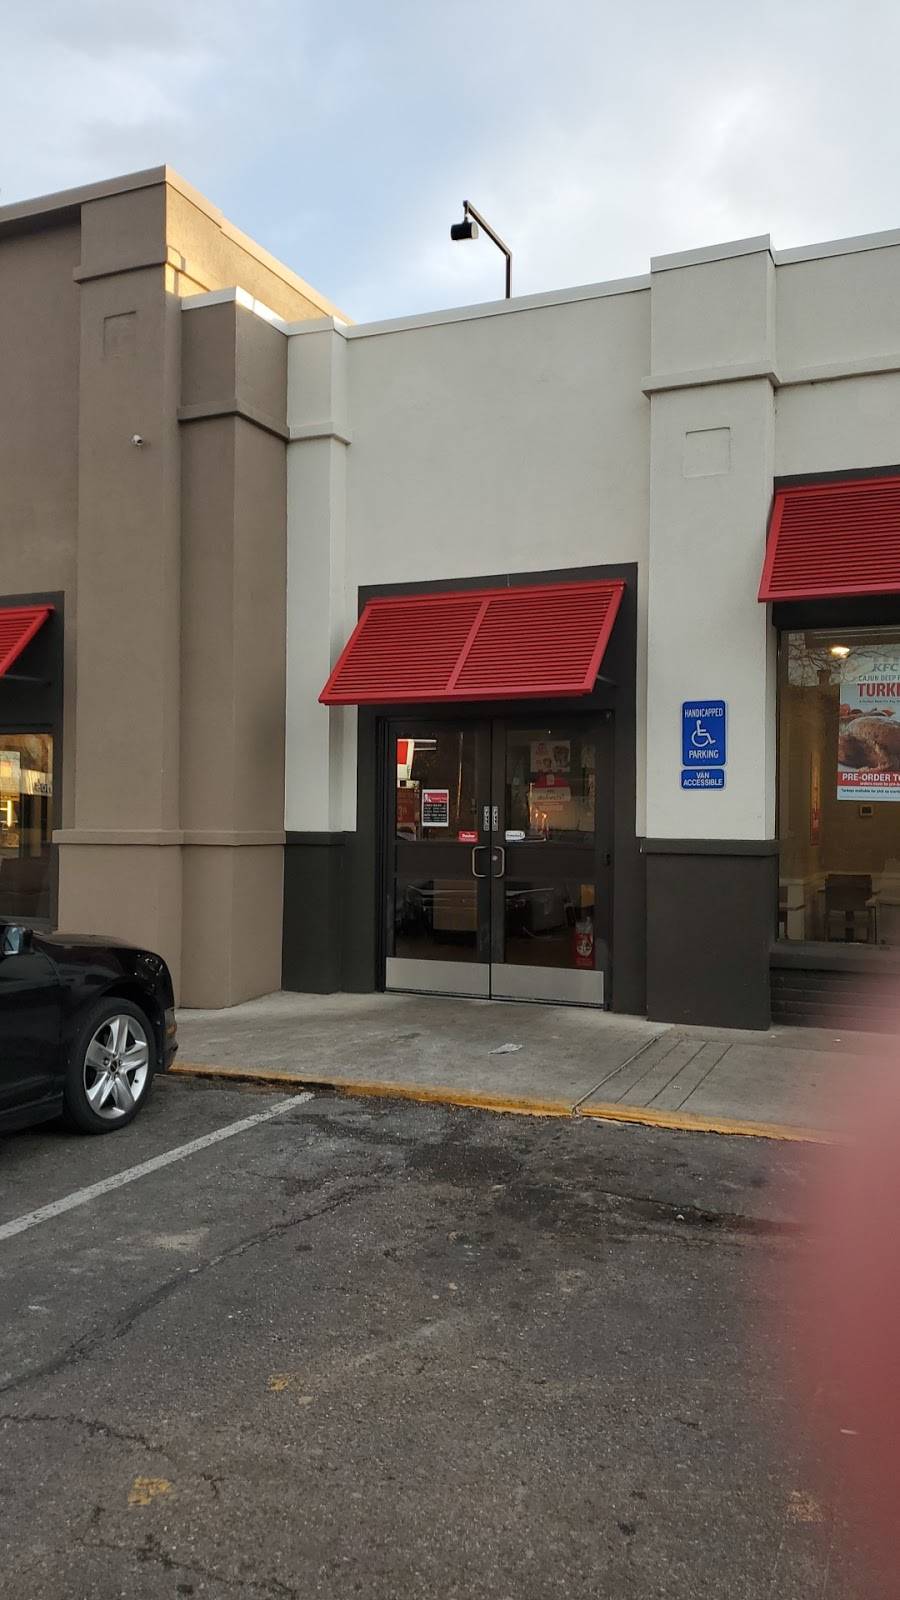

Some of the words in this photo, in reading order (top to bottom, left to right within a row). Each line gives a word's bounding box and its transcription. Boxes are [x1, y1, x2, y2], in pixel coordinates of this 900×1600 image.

[872, 663, 899, 671] KFC
[684, 707, 723, 718] HANDICAPPED
[688, 749, 719, 759] PARKING
[683, 778, 723, 786] ACCESSIBLE
[842, 772, 891, 782] PRE-ORDER
